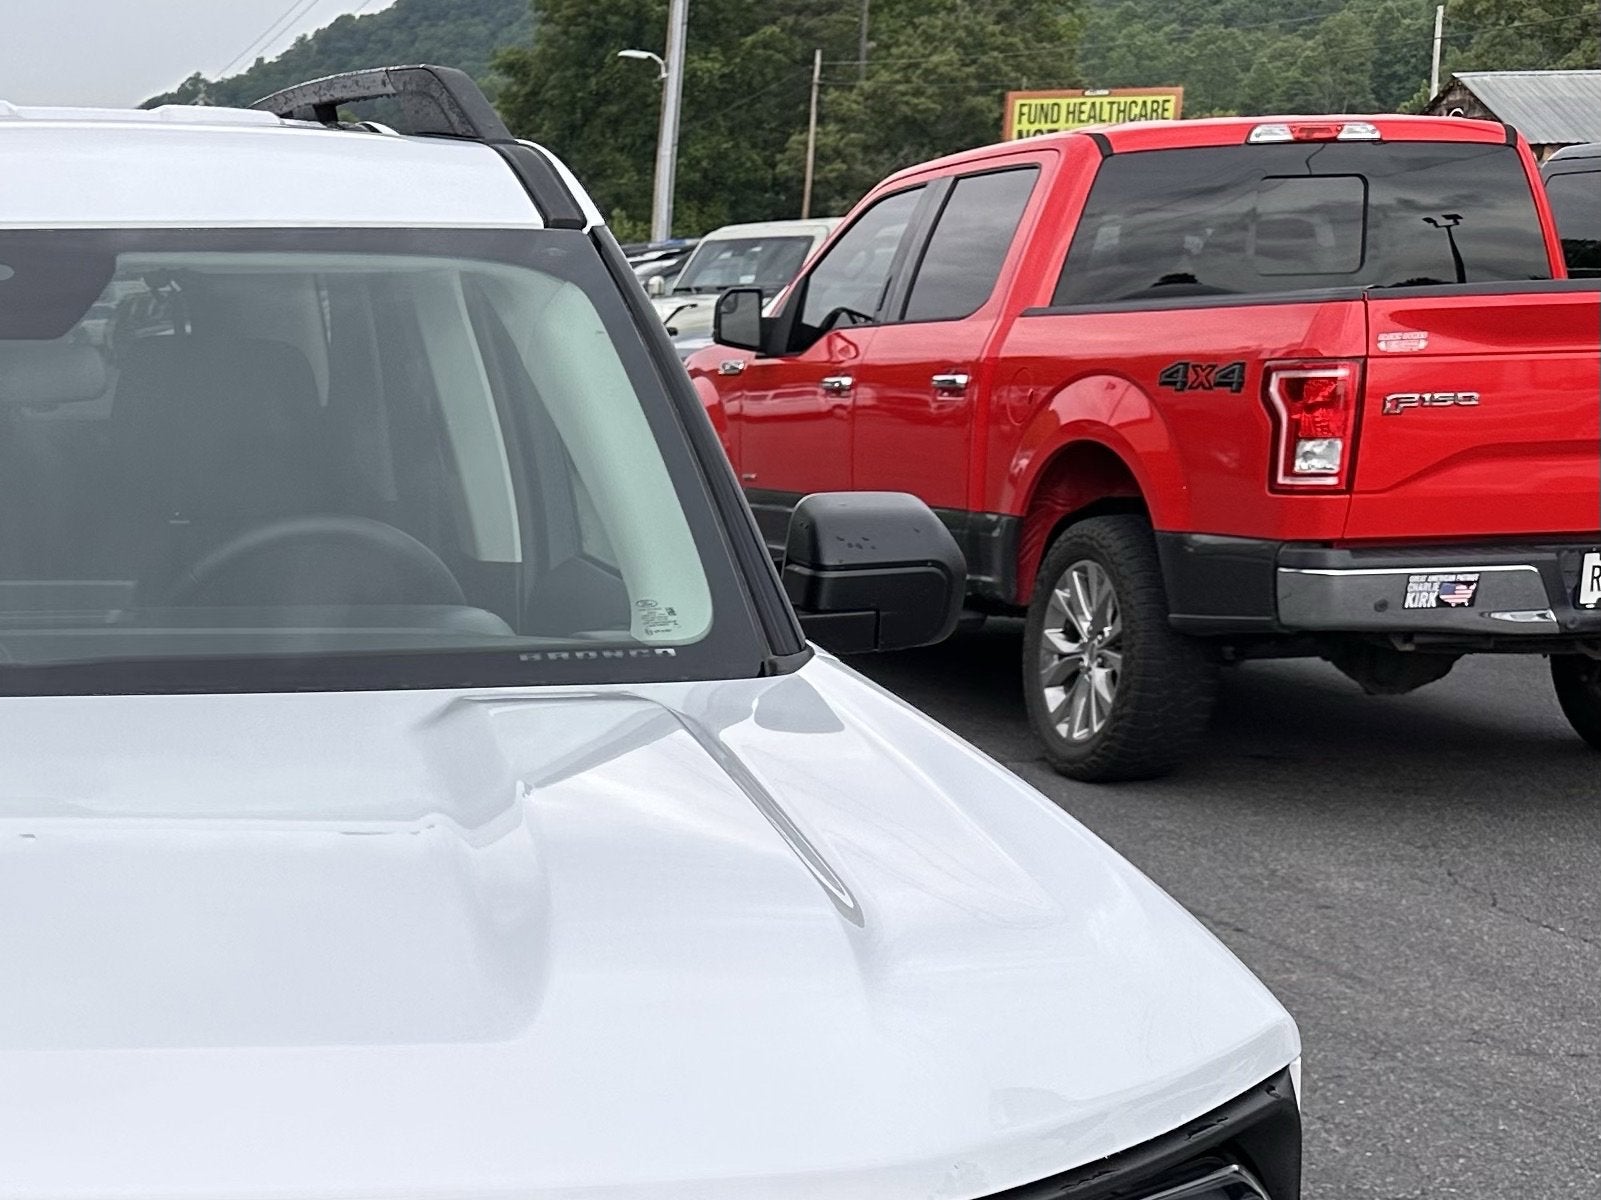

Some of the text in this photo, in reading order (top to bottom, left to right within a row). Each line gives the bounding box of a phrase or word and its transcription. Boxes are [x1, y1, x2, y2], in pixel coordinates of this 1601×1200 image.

[1017, 100, 1171, 125] FUND HEALTHCARE
[1404, 592, 1438, 608] KIRK
